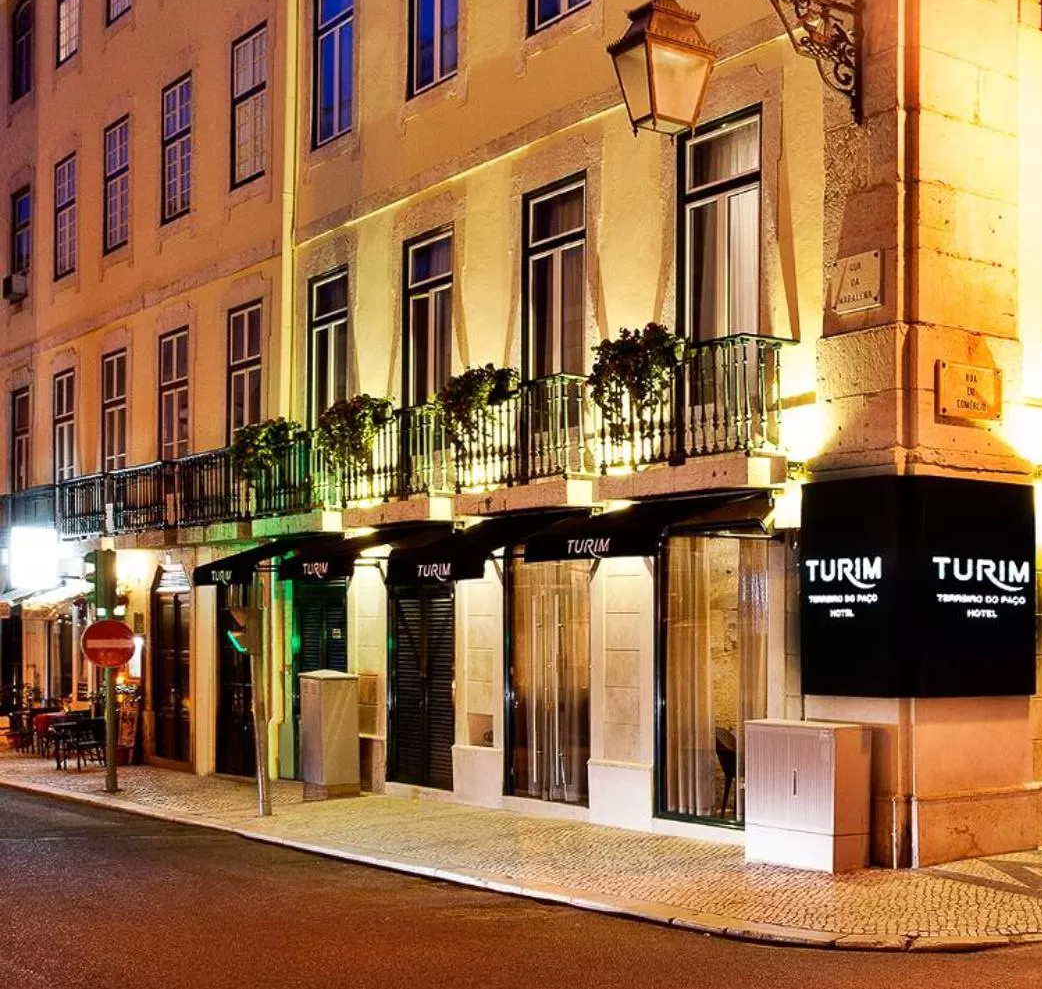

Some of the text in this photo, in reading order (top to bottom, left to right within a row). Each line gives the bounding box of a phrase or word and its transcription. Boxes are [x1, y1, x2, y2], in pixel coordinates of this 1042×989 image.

[566, 536, 612, 559] TURIM
[302, 561, 329, 579] TURIM
[417, 562, 452, 581] TURIM
[805, 556, 882, 590] TURIM
[932, 556, 1031, 592] TURIM
[984, 594, 1000, 605] DO
[1000, 594, 1027, 606] PAÇO
[829, 608, 856, 618] HOTEL
[966, 608, 998, 619] HOTEL
